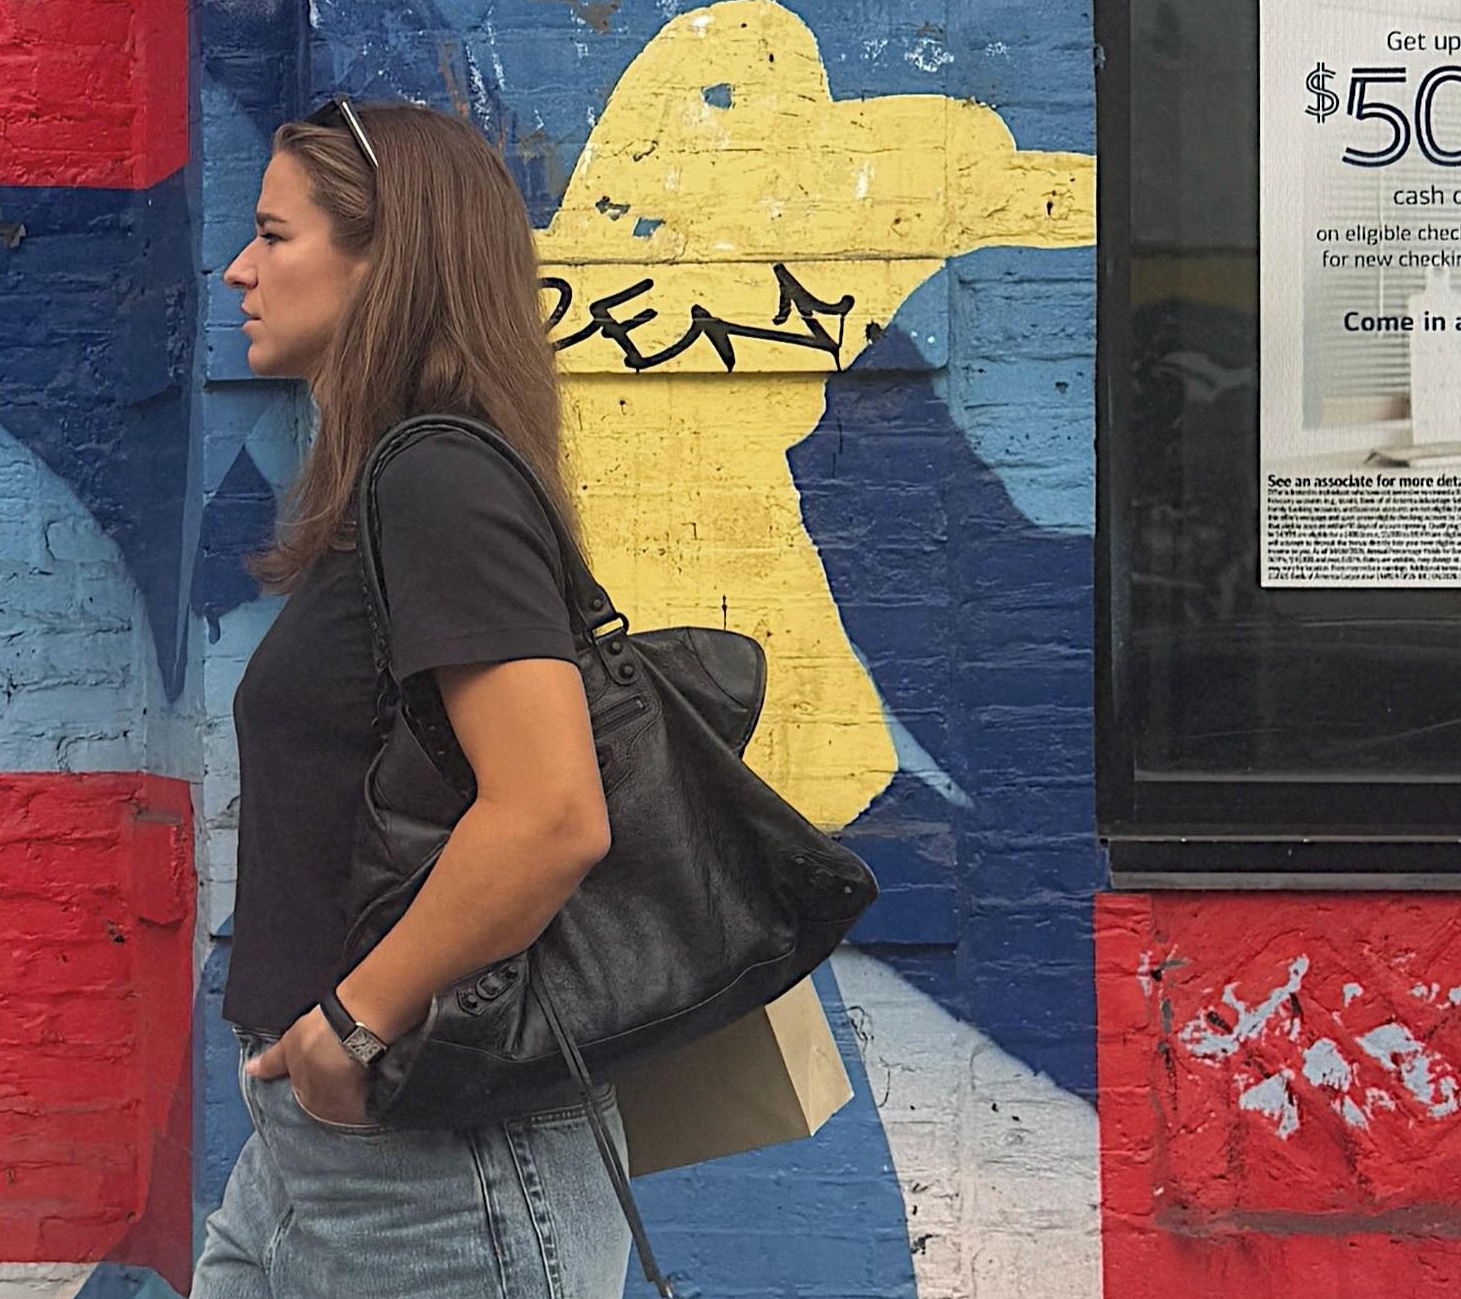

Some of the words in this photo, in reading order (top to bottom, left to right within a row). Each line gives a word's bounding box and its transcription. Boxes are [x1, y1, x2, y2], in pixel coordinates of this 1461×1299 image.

[1387, 30, 1426, 51] Get
[1434, 34, 1461, 56] up
[1393, 184, 1444, 206] cash
[1316, 228, 1340, 242] on
[1345, 224, 1412, 246] eligible
[1418, 223, 1461, 241] chec
[1322, 249, 1350, 268] for
[1354, 253, 1393, 268] new
[1344, 311, 1414, 332] Come
[1424, 310, 1446, 332] in
[1267, 474, 1292, 488] See
[1294, 477, 1311, 488] an
[1314, 474, 1374, 488] associate
[1376, 473, 1396, 488] for
[1399, 477, 1434, 488] more
